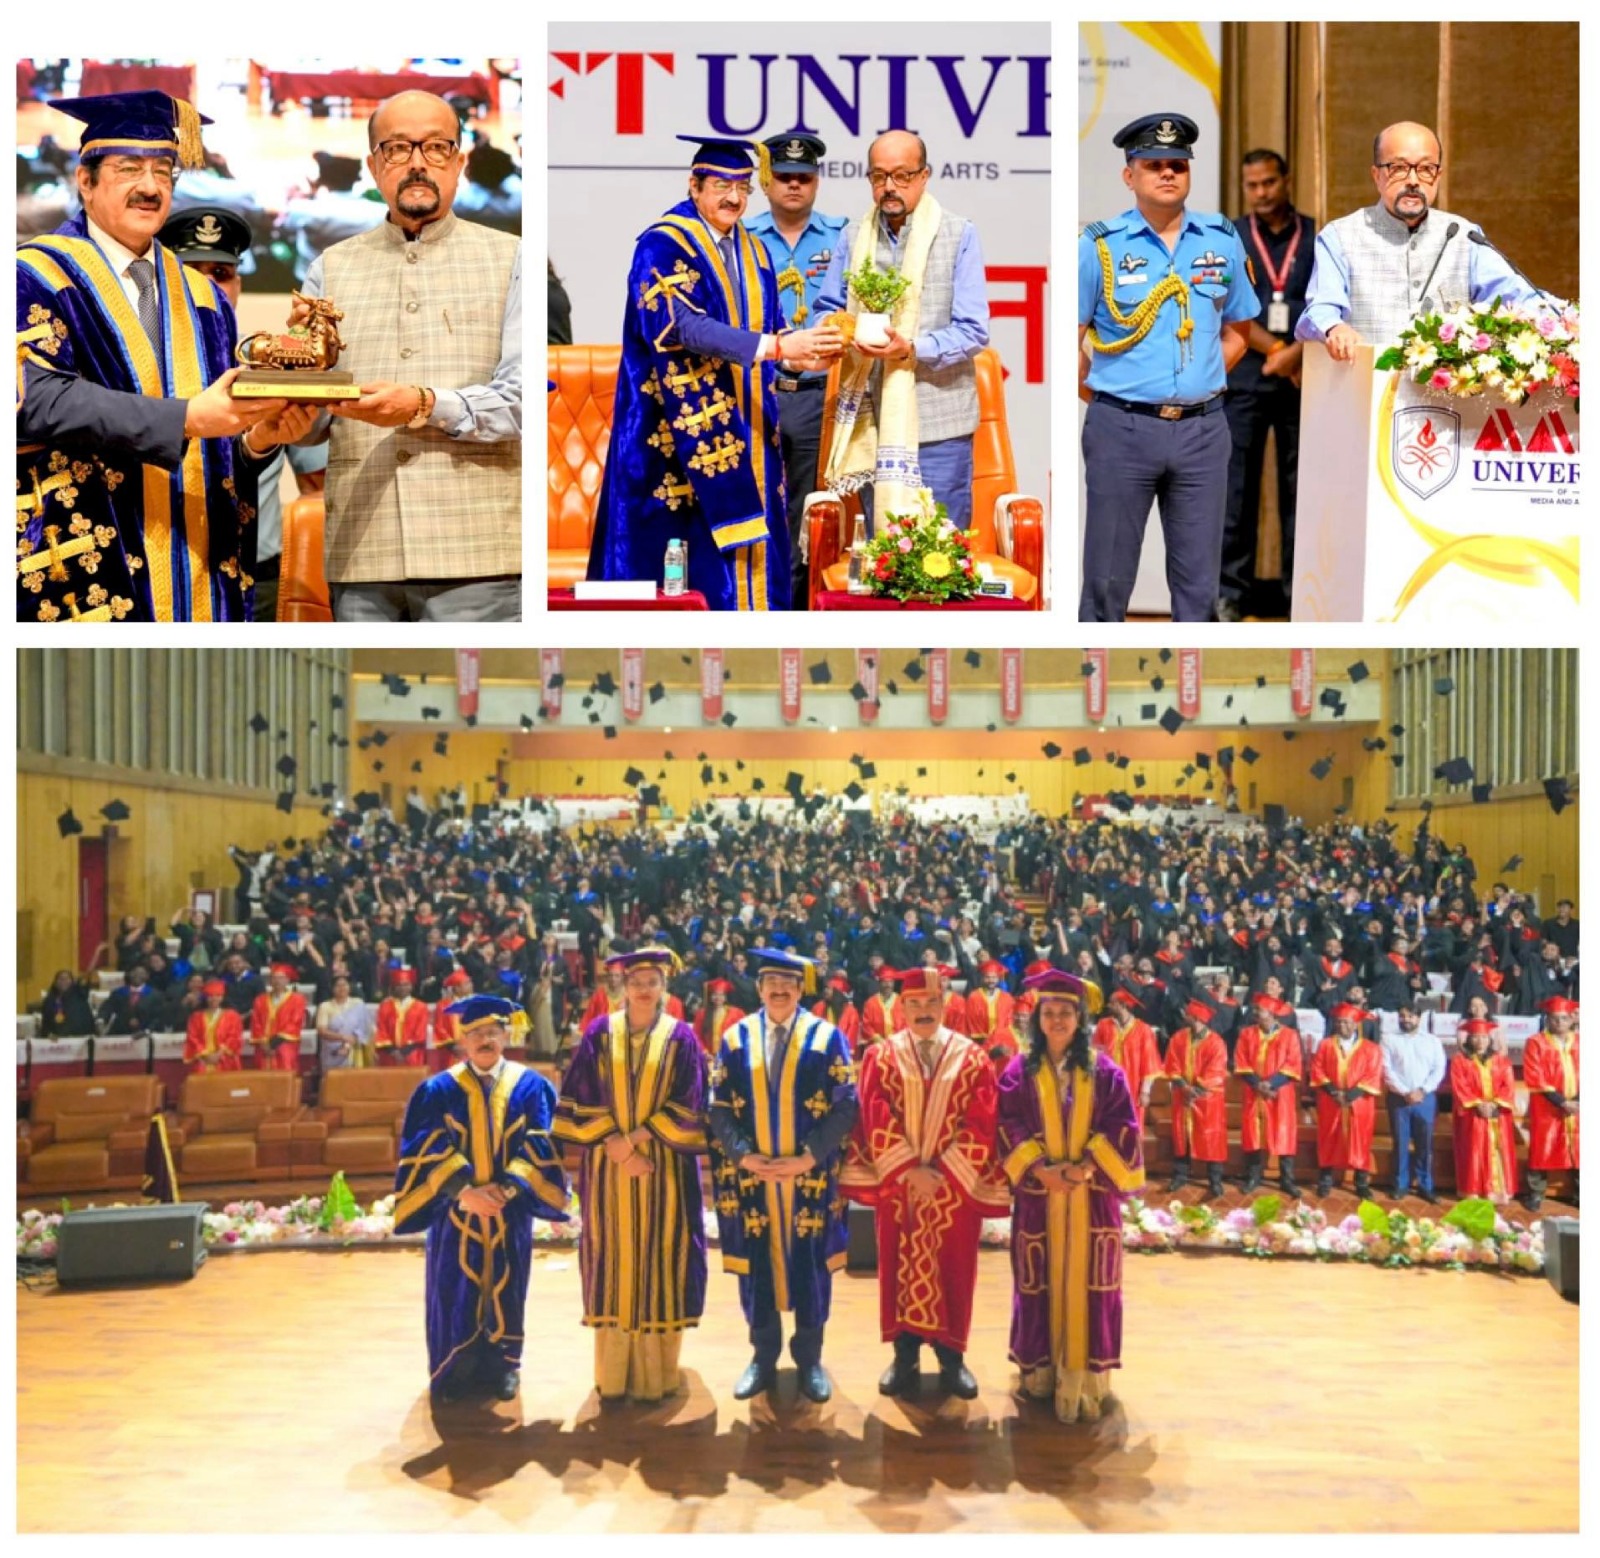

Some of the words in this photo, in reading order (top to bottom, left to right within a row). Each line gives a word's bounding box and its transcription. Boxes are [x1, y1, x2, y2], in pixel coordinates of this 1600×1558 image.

[940, 162, 1000, 180] ARTS
[1556, 498, 1572, 506] AND
[785, 657, 798, 706] MUSIC
[1183, 654, 1197, 704] CINEMA
